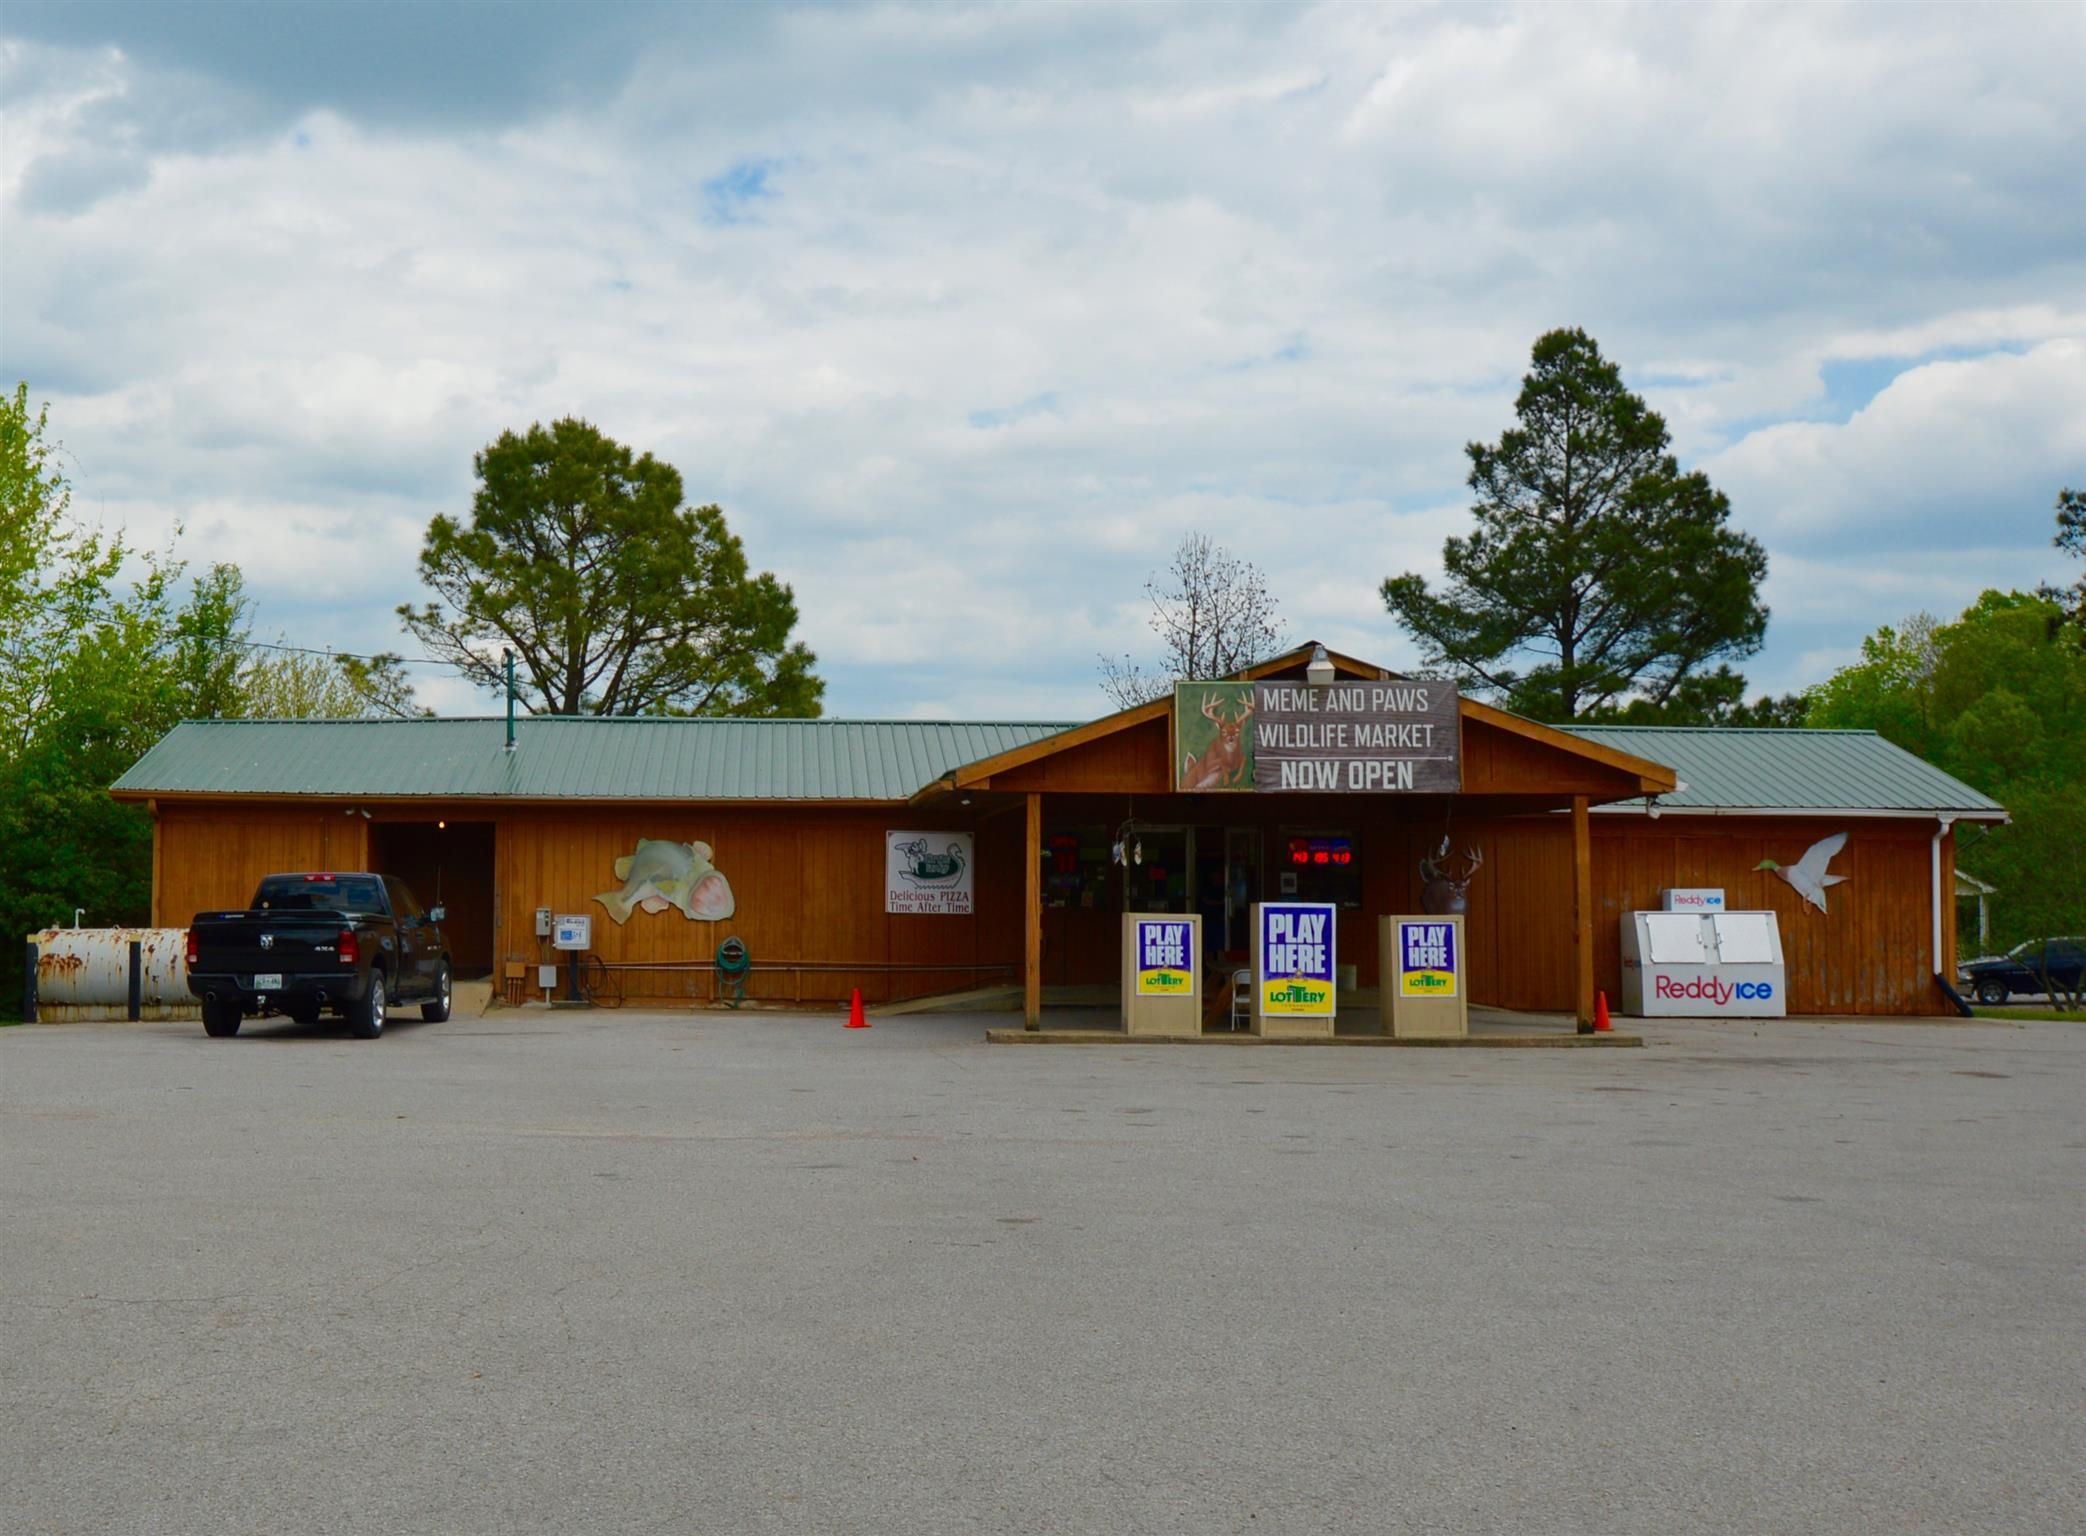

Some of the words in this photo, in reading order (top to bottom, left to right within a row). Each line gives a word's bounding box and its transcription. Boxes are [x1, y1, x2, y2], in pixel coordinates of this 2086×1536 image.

[1263, 688, 1319, 712] MEME
[1325, 688, 1364, 712] AND
[1372, 688, 1428, 712] PAWS
[1259, 724, 1348, 748] WILDLIFE
[1355, 724, 1434, 748] MARKET
[1281, 761, 1340, 790] NOW
[1348, 761, 1413, 790] OPEN
[889, 890, 935, 901] Delicious
[940, 891, 970, 902] PIZZA
[889, 901, 913, 912] Time
[918, 902, 942, 913] After
[946, 902, 970, 913] Time
[1145, 925, 1183, 945] PLAY
[1269, 913, 1326, 943] PLAY
[1407, 926, 1446, 946] PLAY
[1145, 945, 1184, 965] HERE
[1269, 944, 1326, 973] HERE
[1408, 947, 1447, 967] HERE
[1146, 973, 1184, 985] LOTTERY
[1409, 975, 1447, 986] LOTTERY
[1270, 985, 1325, 1003] LOTTERY
[1656, 975, 1734, 1006] Reddy
